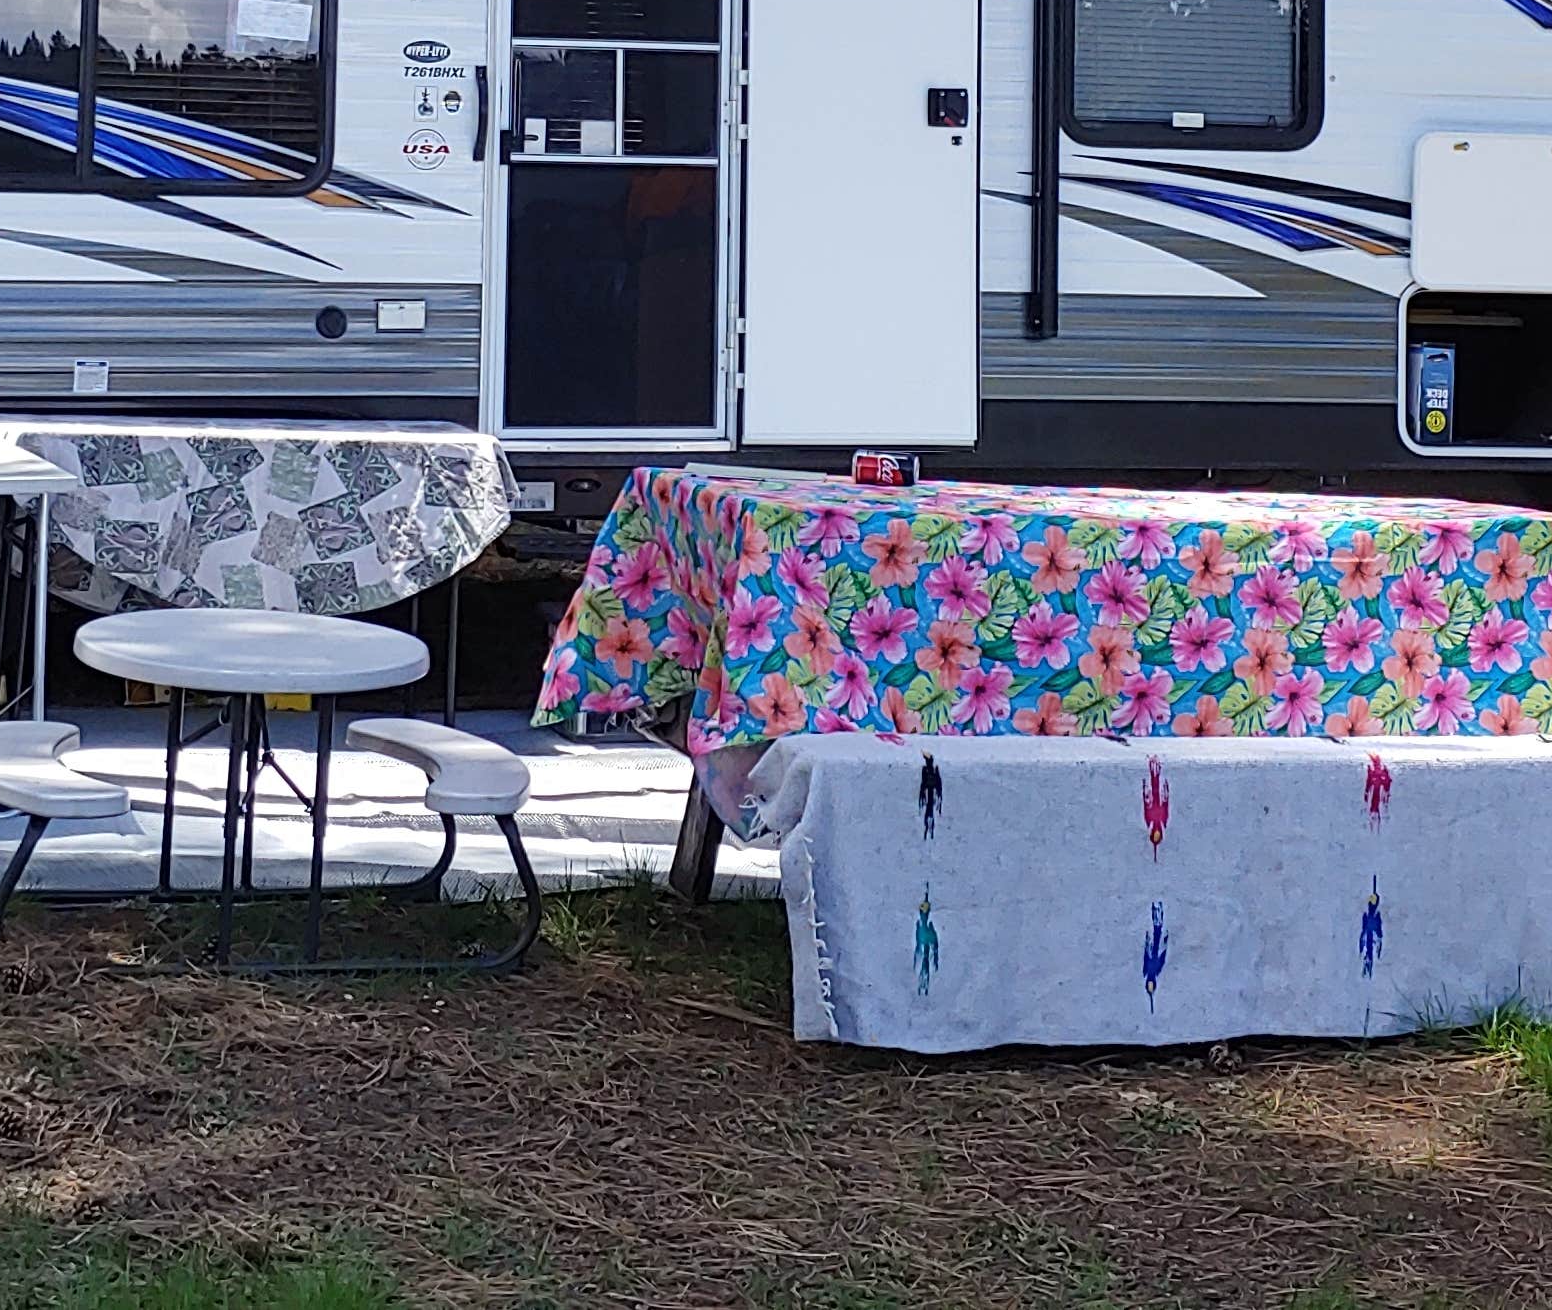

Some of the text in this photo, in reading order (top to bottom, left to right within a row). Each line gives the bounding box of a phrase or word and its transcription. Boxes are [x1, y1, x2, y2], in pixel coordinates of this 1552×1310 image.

[404, 66, 467, 78] T261BHXL
[402, 144, 451, 155] USA
[1424, 388, 1449, 399] DECK
[1425, 399, 1449, 409] STEP
